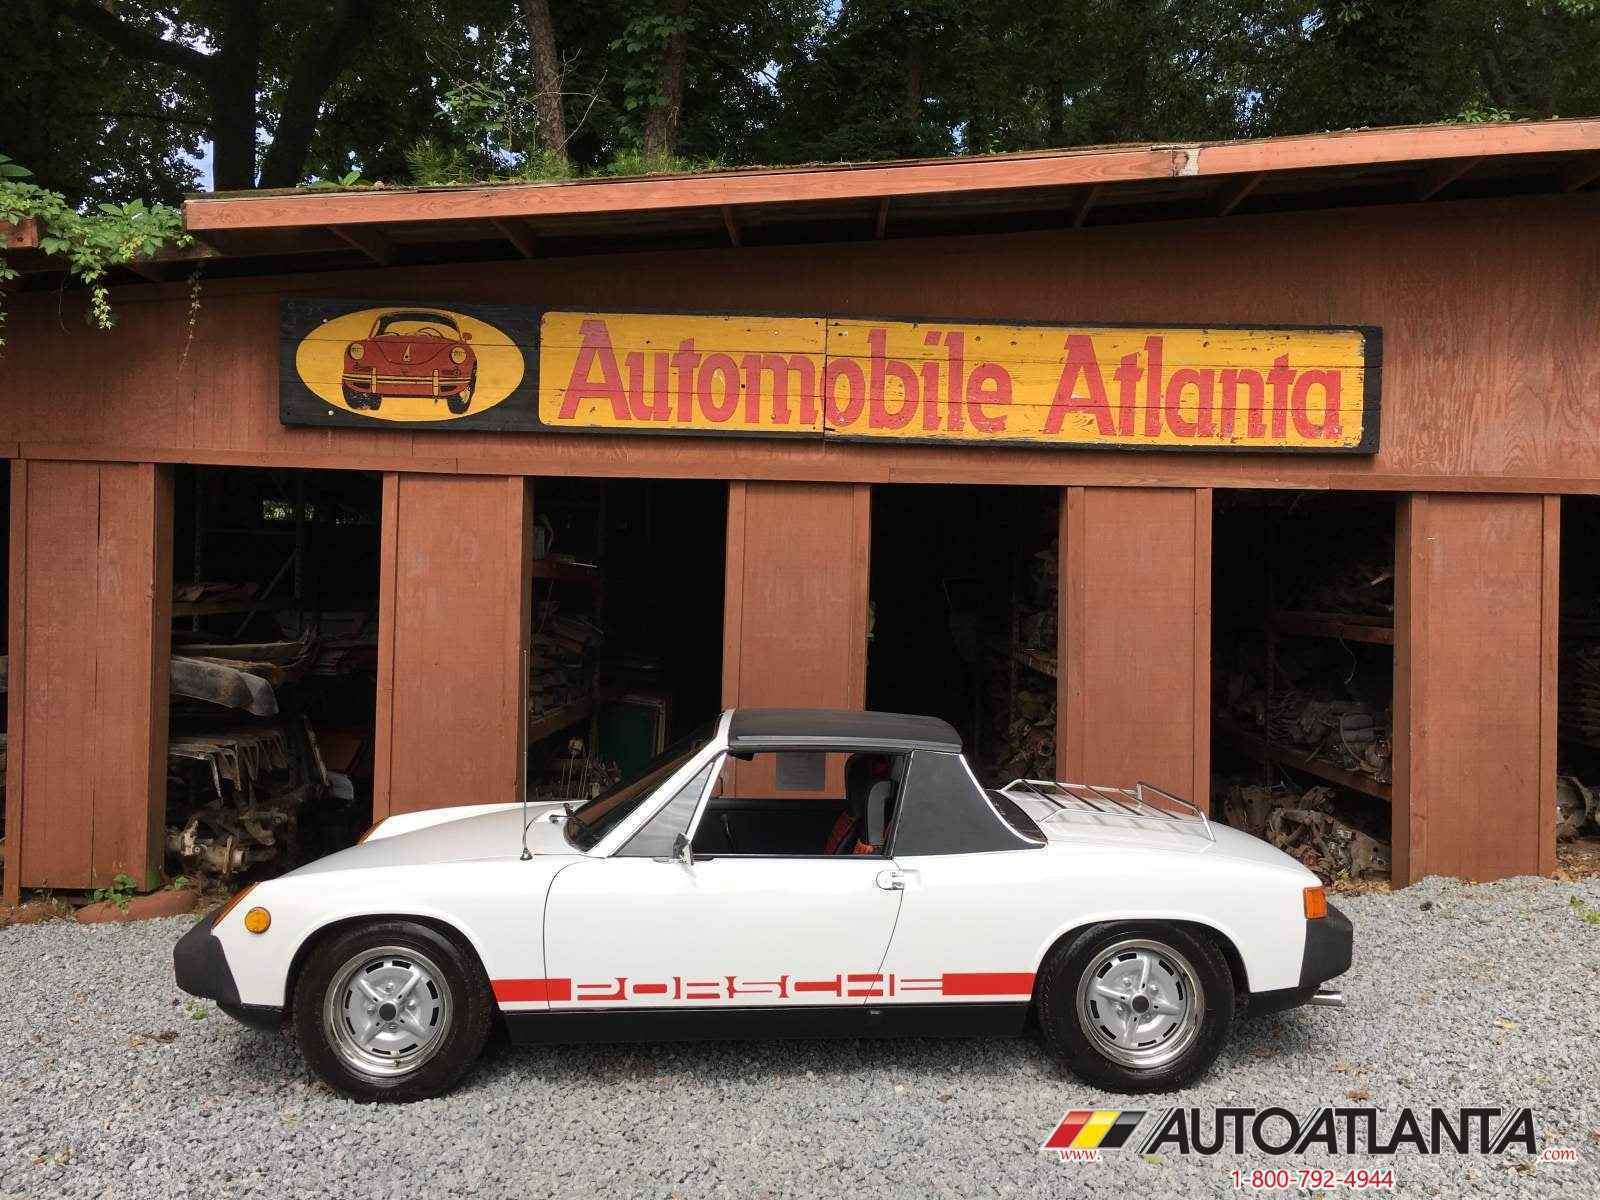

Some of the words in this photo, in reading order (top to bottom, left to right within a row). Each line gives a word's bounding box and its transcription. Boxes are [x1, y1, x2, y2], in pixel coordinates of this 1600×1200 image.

[558, 319, 1013, 434] Automobile
[1043, 334, 1344, 440] Atlanta
[571, 973, 943, 1002] PORSCHE
